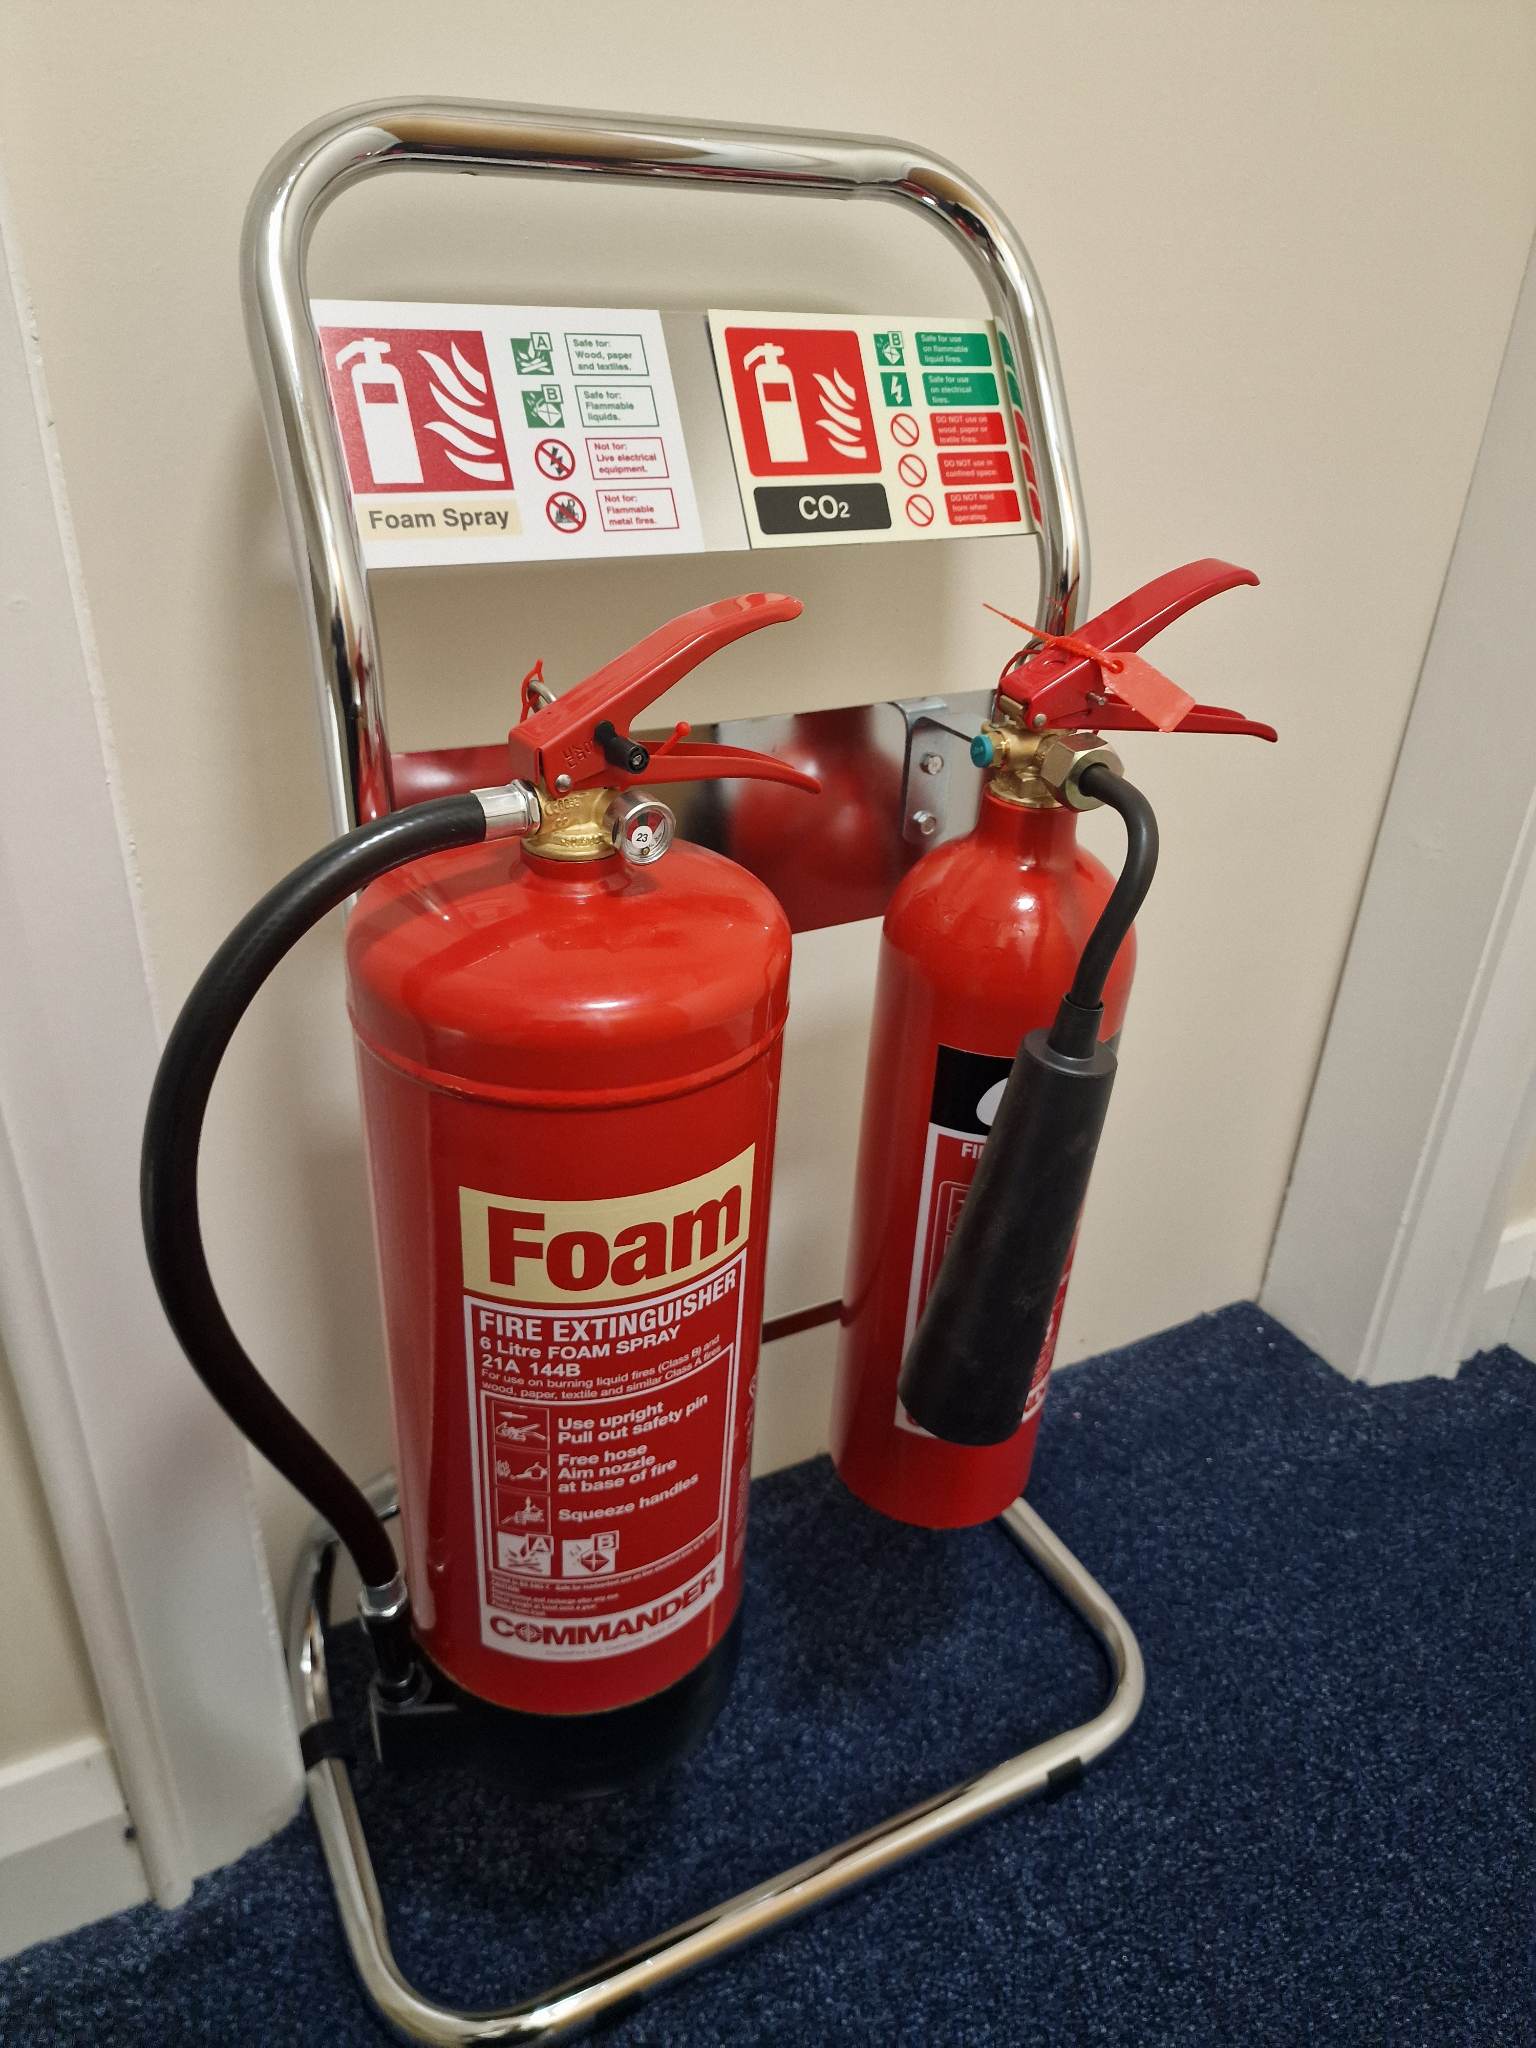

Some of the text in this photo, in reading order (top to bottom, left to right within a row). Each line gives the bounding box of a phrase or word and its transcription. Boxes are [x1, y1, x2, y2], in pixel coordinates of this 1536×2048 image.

[537, 335, 549, 348] A
[572, 339, 611, 348] Safe for:
[891, 332, 900, 345] B
[921, 335, 936, 343] Safe
[938, 335, 948, 343] for
[933, 345, 969, 353] flammable
[574, 351, 632, 361] Wood, paper
[924, 355, 944, 364] liquid
[578, 363, 631, 371] and textiles.
[546, 388, 558, 400] B
[583, 391, 622, 399] Safe for:
[585, 401, 634, 410] Flammable
[587, 412, 621, 422] liquids.
[594, 443, 628, 451] Not for:
[596, 453, 657, 462] Live electrical
[599, 465, 648, 475] equipment.
[604, 495, 638, 503] Not for:
[606, 505, 655, 514] Flammable
[798, 494, 851, 520] CO2
[368, 508, 509, 531] Foam Spray
[609, 516, 657, 526] metal fires.
[636, 832, 649, 843] 23
[487, 1184, 742, 1291] Foam
[480, 1268, 737, 1342] FIRE EXTINGUISHER
[480, 1324, 681, 1360] 6 Litre FOAM SPRAY
[481, 1368, 500, 1380] For
[503, 1374, 525, 1385] use
[546, 1379, 594, 1389] burning
[595, 1372, 629, 1387] liquid
[630, 1367, 656, 1380] fires
[657, 1353, 690, 1374] (Class
[703, 1333, 720, 1352] and
[481, 1354, 581, 1377] 21A 144B
[561, 1389, 598, 1399] textile
[599, 1385, 624, 1397] and
[625, 1375, 663, 1393] similar
[664, 1363, 693, 1380] Class
[694, 1356, 703, 1368] A
[558, 1401, 664, 1431] Use upright
[558, 1394, 708, 1445] Pull out safety pin
[558, 1444, 648, 1467] Free hose
[558, 1455, 656, 1479] Aim nozzle
[558, 1459, 678, 1493] at base of fire
[558, 1473, 699, 1523] Squeeze handles
[530, 1536, 550, 1551] A
[597, 1533, 615, 1550] B
[489, 1567, 716, 1646] COMMANDER
